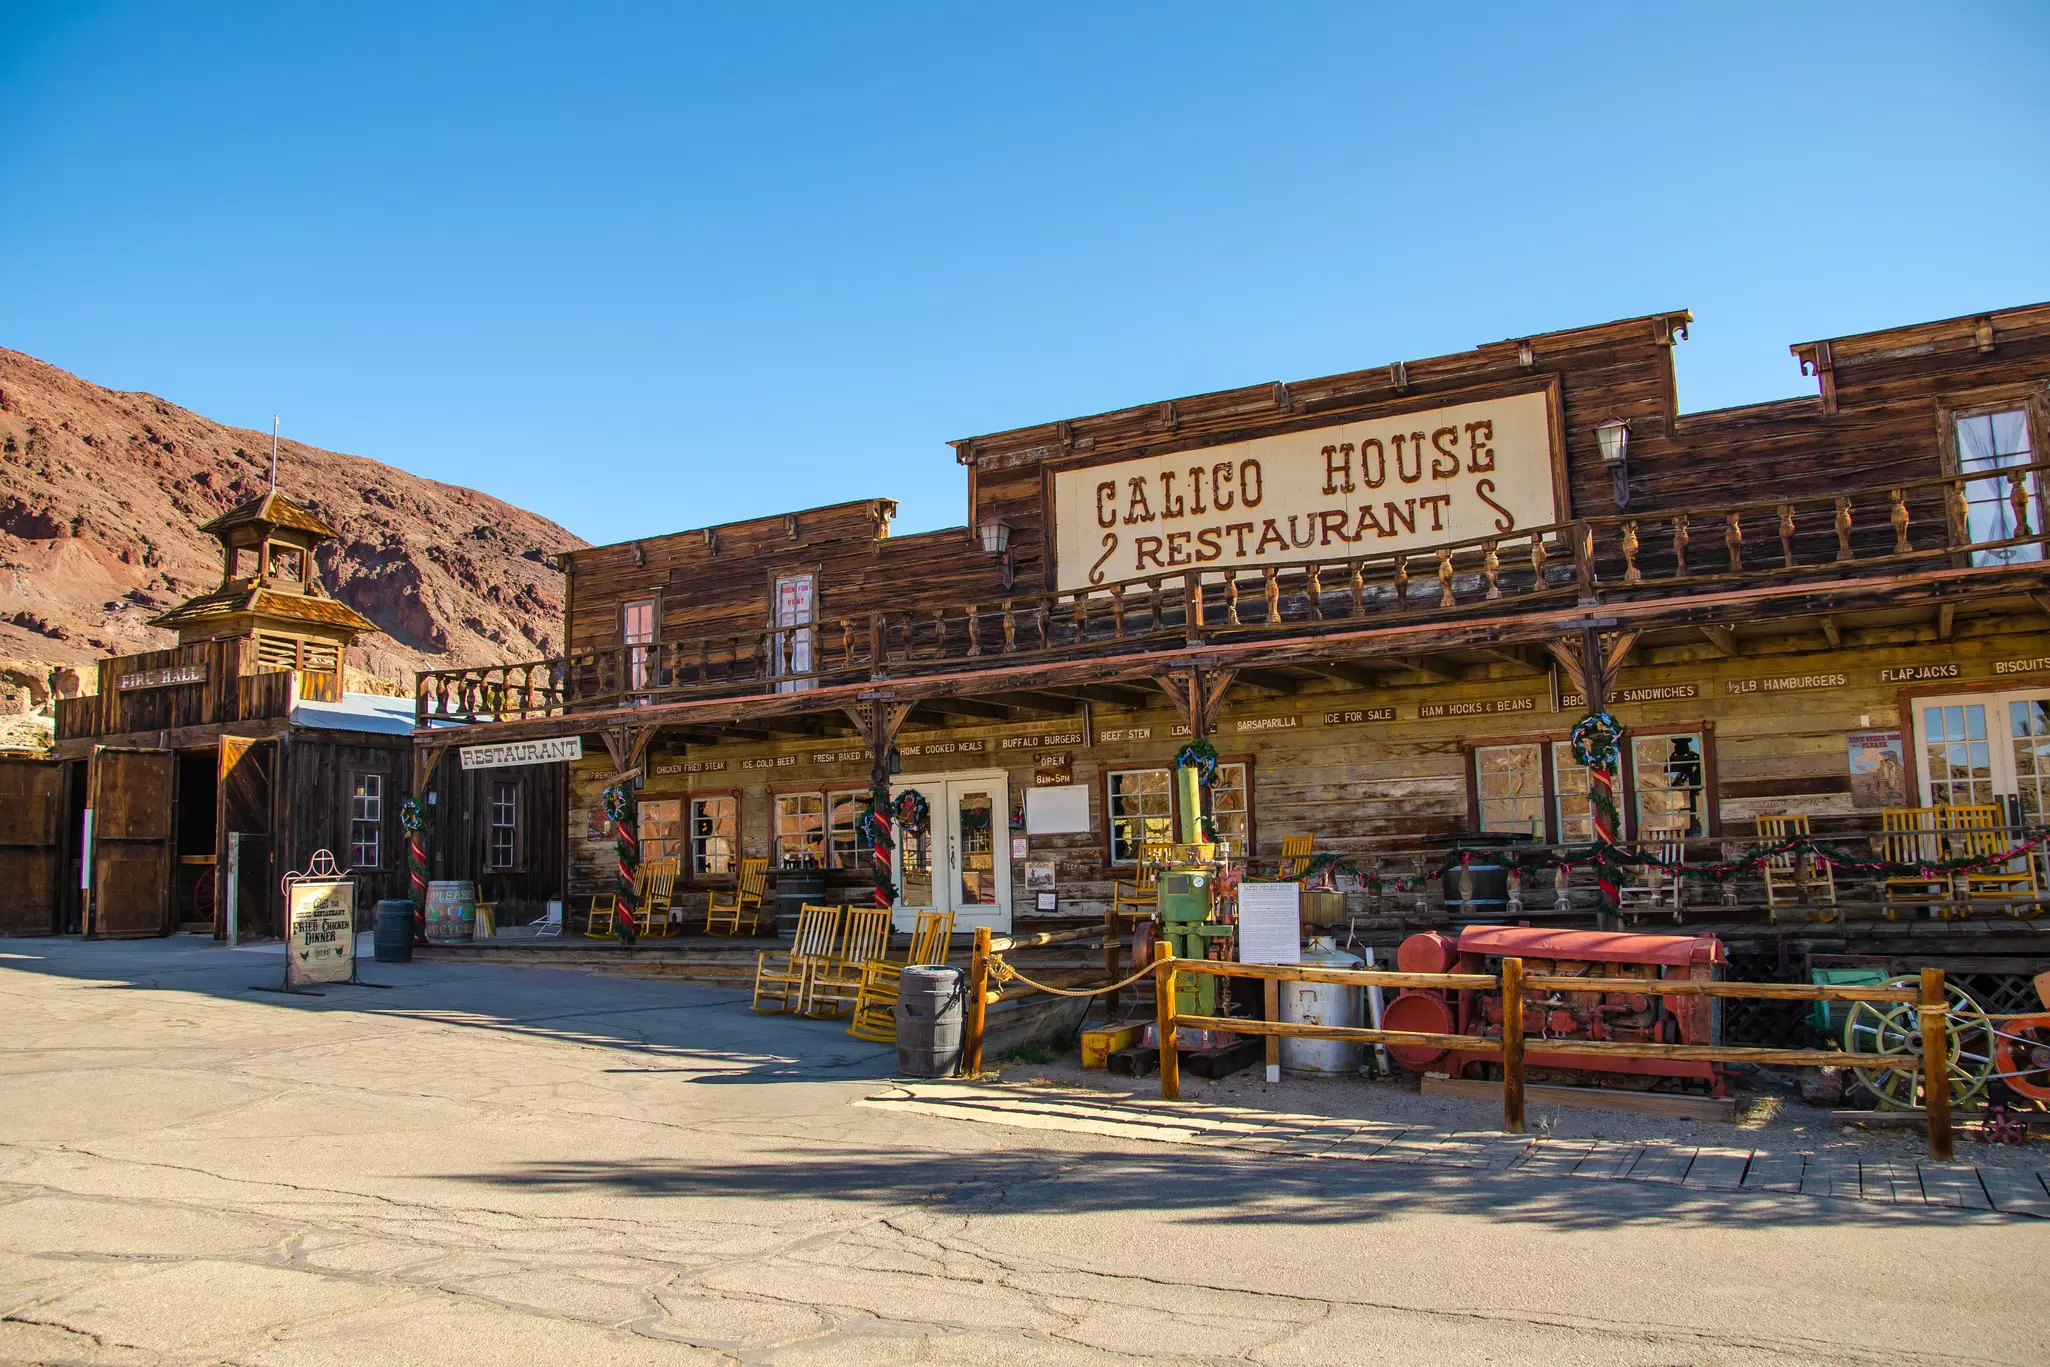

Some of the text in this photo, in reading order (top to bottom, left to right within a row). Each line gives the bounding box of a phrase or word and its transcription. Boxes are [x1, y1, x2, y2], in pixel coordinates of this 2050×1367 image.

[1097, 419, 1494, 528] CALICO HOUSE
[1135, 494, 1451, 571] RESTAURANT
[1882, 664, 1958, 682] FLAPJACKS
[1996, 658, 2050, 674] BISCUITS
[121, 666, 200, 689] FIRE HALL
[1763, 674, 1845, 690] HAMBURGERS
[1623, 686, 1694, 702] SANDWICHES
[1422, 706, 1444, 717] HAM
[1450, 702, 1483, 714] HOCKS
[1497, 698, 1532, 711] BEANS
[1236, 716, 1296, 732] SARSAPARILLA
[1324, 708, 1392, 724] ICE FOR SALE
[1002, 734, 1081, 748] BUFFALO BURGERS
[1101, 728, 1151, 741] BEEF STEW
[462, 740, 578, 766] RESTAURANT
[900, 741, 983, 756] HOME COOKED MEALS
[742, 756, 796, 769] ICE COLD BEER
[813, 753, 834, 764] FRESH
[838, 751, 861, 762] BAKED
[1040, 756, 1065, 767] OPEN
[656, 762, 725, 774] CHICKEN FRIED STEAK
[1036, 774, 1070, 784] 8AM-5PM
[292, 920, 350, 936] FRIED CHICKEN
[304, 930, 336, 946] DINNER
